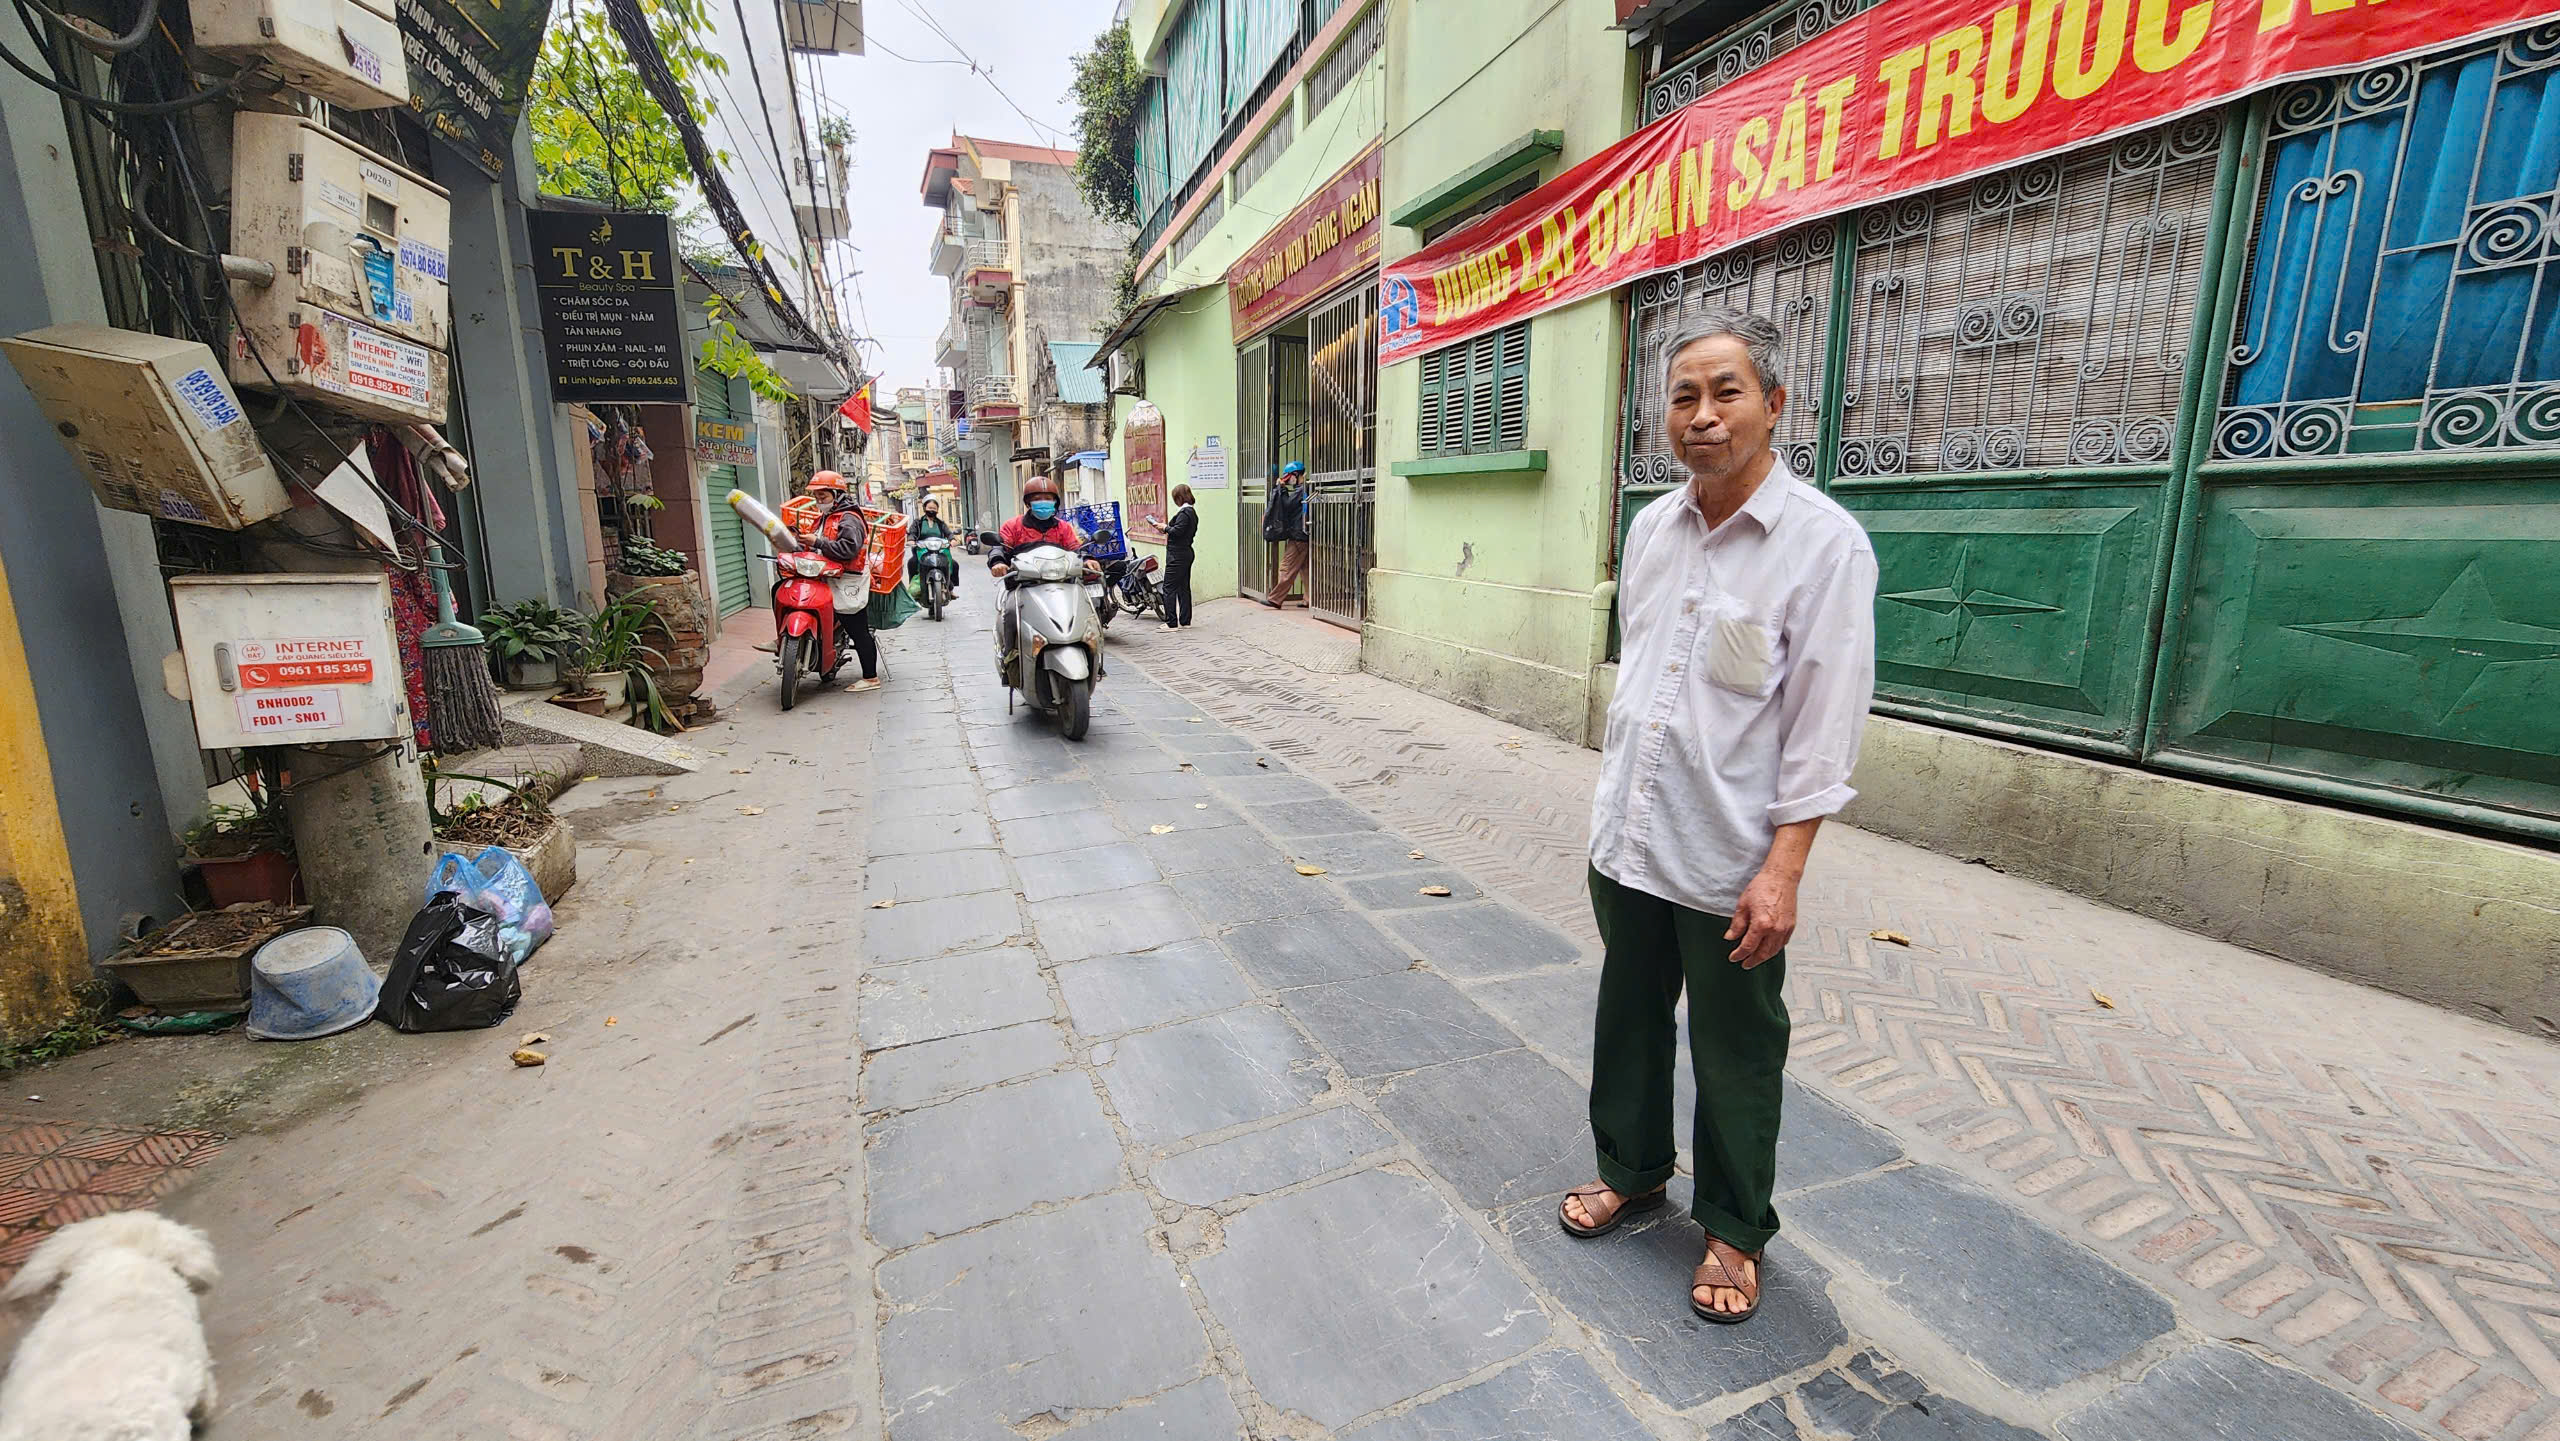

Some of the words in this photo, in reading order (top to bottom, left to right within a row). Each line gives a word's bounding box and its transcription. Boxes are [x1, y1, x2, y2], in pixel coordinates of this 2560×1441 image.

[477, 63, 505, 99] NHANG
[366, 168, 392, 188] D0203
[1519, 206, 1577, 299] LẠI
[1589, 138, 1714, 268] QUAN
[1727, 75, 1857, 211] SÁT
[1285, 234, 1306, 276] NON
[552, 247, 583, 278] T
[589, 256, 614, 280] &
[619, 250, 656, 281] H
[579, 282, 614, 293] Beauty
[615, 283, 635, 293] Spa
[592, 296, 613, 306] SÓC
[615, 298, 630, 306] DA
[586, 327, 622, 336] NHANG
[353, 340, 398, 361] INTERNET
[406, 355, 423, 368] Wifi
[566, 344, 591, 352] PHUN
[625, 344, 646, 353] NAIL
[654, 345, 666, 353] MI
[364, 364, 380, 373] DATA
[592, 357, 619, 368] LÔNG
[400, 365, 426, 378] CAMERA
[351, 373, 412, 398] 0918.962.134
[571, 376, 587, 384] Linh
[627, 377, 678, 385] 0986.245.453
[698, 422, 744, 442] KEM
[724, 441, 753, 455] Chua
[275, 640, 364, 653] INTERNET
[279, 665, 311, 676] 0961
[316, 664, 340, 674] 185
[342, 663, 367, 673] 345
[256, 696, 314, 710] BNH0002
[253, 715, 283, 726] FD01
[295, 712, 327, 723] SN01
